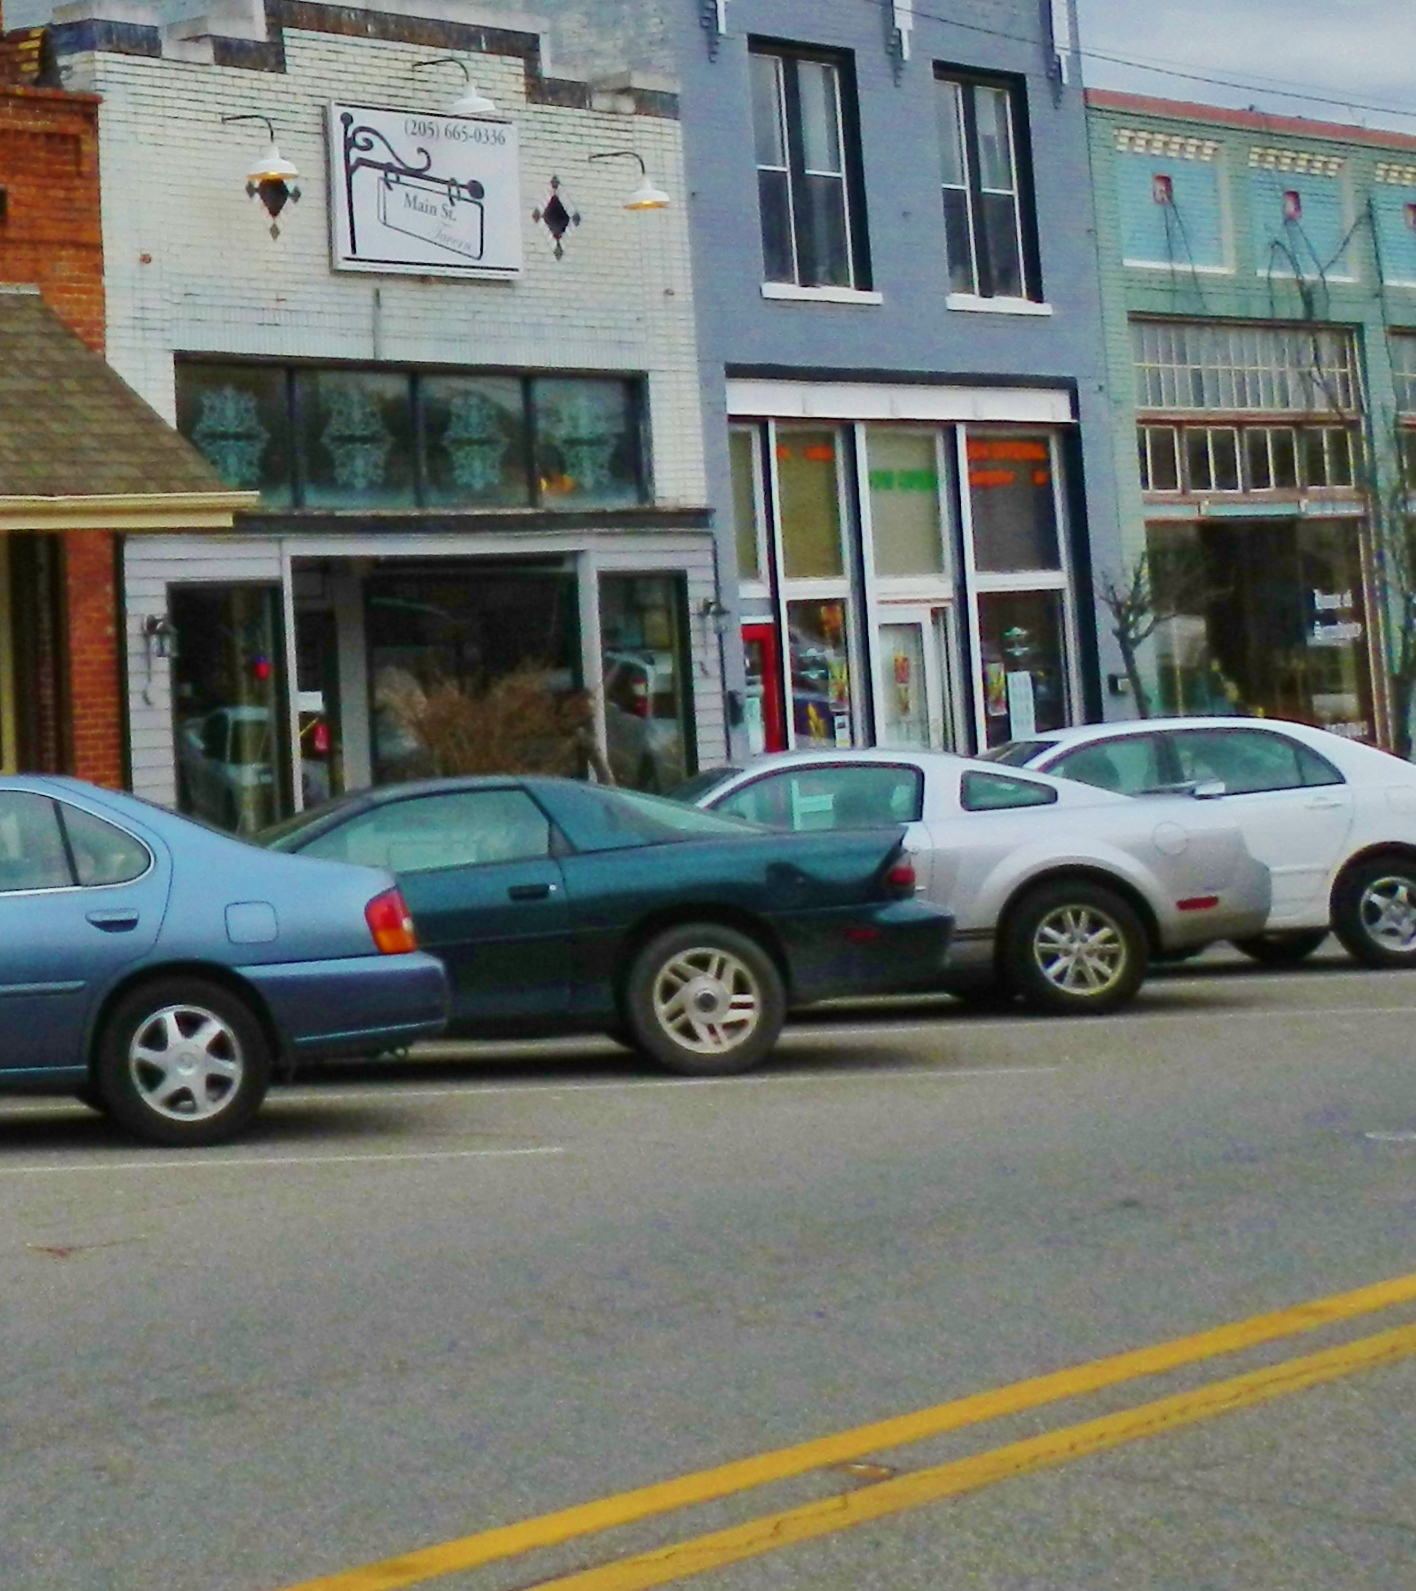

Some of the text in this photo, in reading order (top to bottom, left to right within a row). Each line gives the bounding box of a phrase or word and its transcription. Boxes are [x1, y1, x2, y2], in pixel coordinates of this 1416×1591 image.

[403, 119, 506, 146] (205) 665-0336
[403, 192, 438, 217] Main
